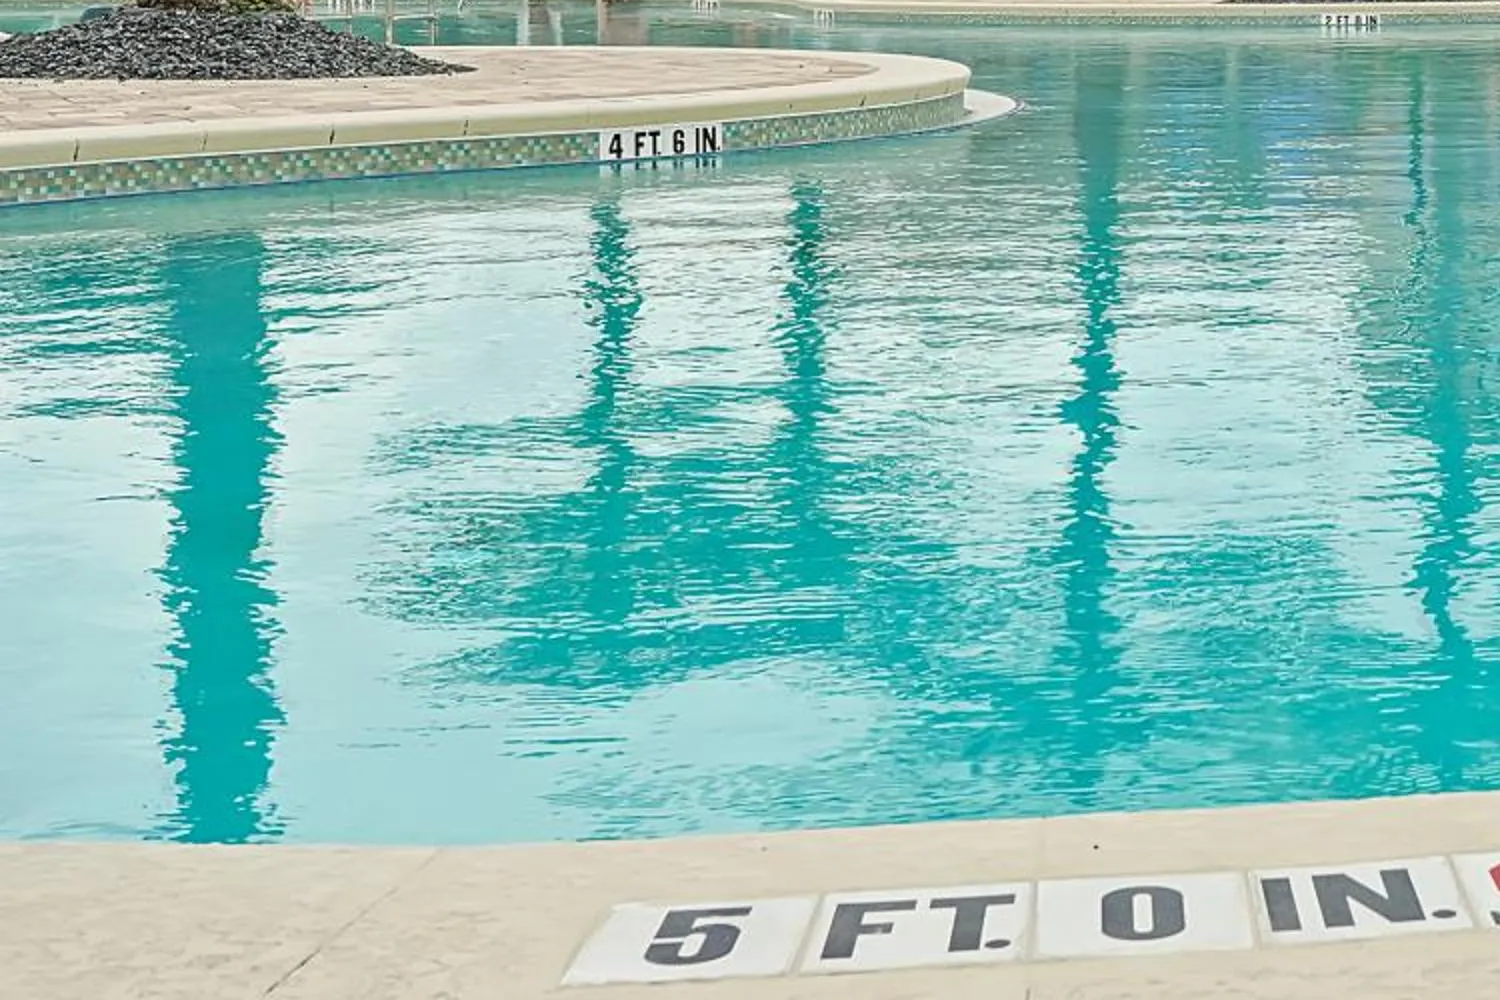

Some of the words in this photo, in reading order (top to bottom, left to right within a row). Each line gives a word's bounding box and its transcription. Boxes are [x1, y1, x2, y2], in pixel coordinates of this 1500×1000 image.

[609, 133, 623, 158] 4
[635, 130, 661, 156] FT.
[673, 129, 685, 154] 6
[695, 126, 720, 154] IN.
[644, 907, 752, 965] 5
[821, 894, 1015, 960] FT.
[1102, 886, 1185, 940] 0
[1261, 869, 1457, 932] IN.
